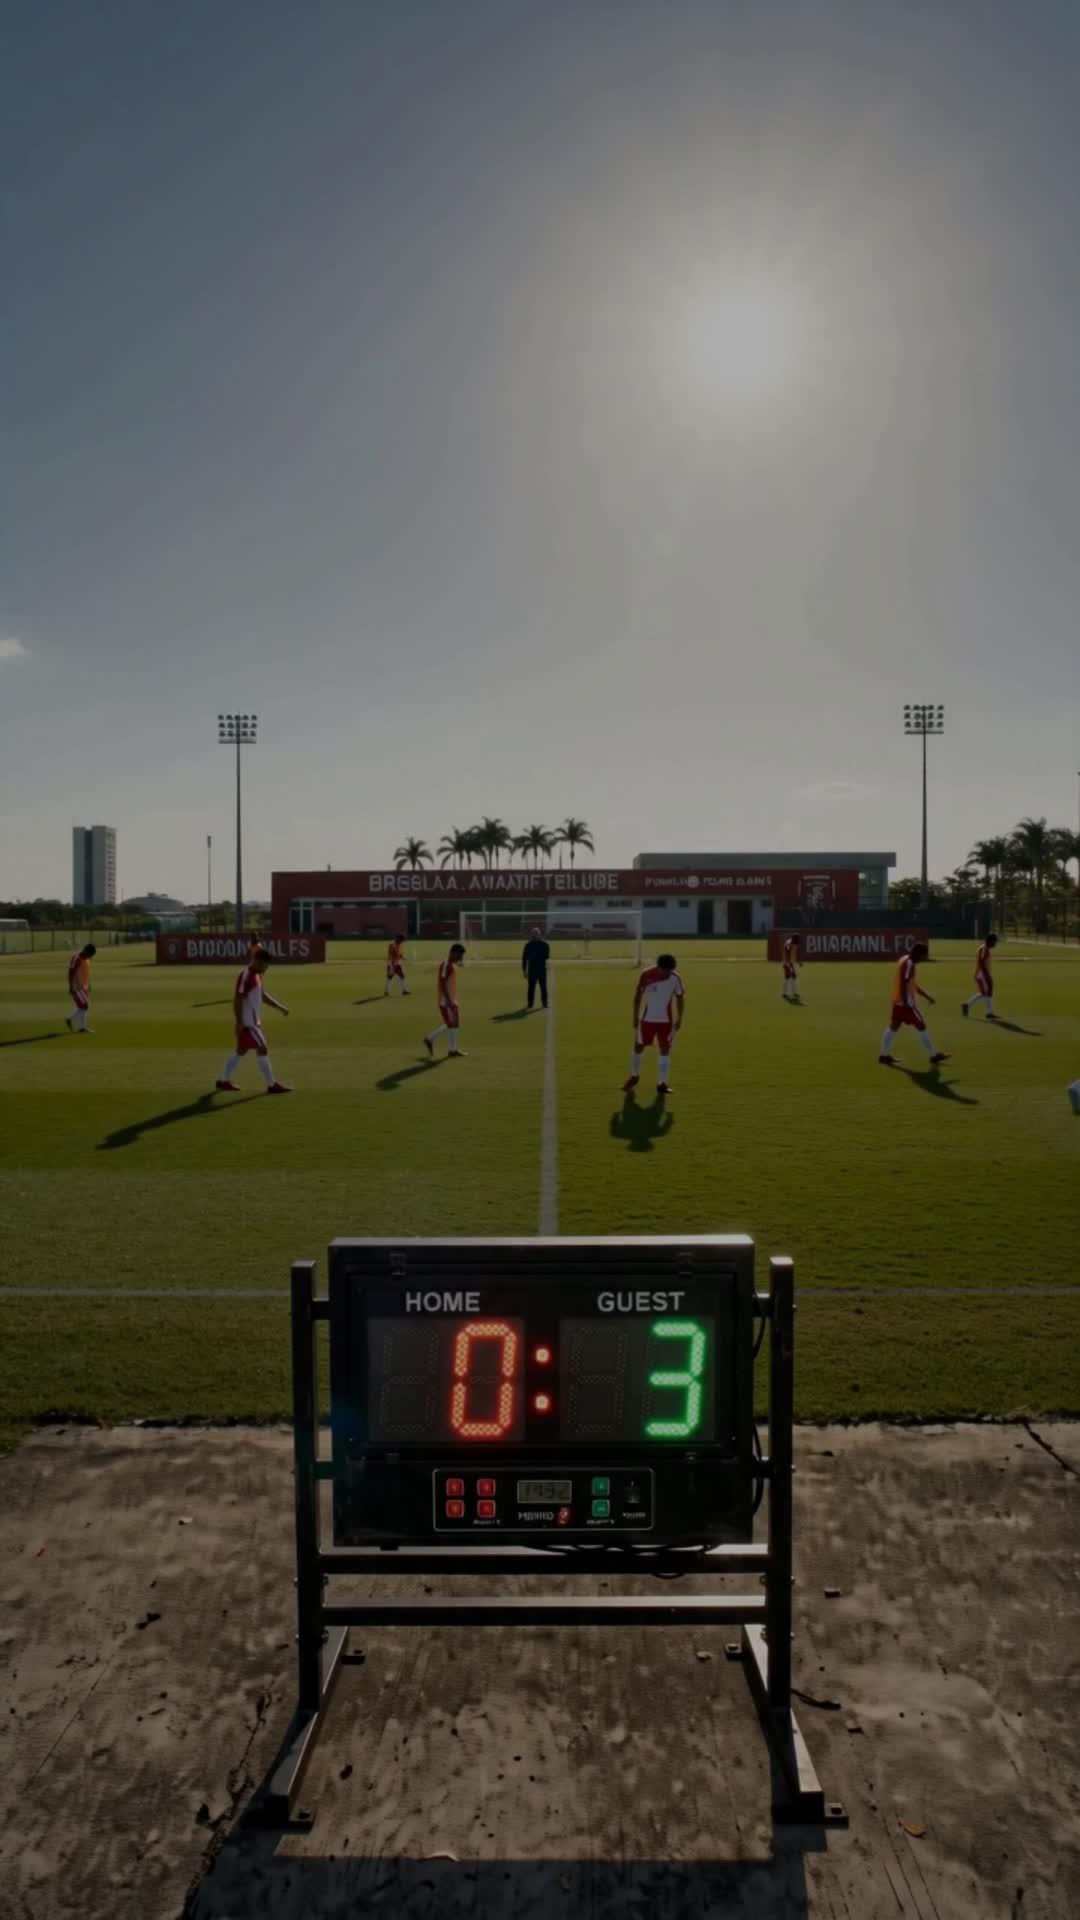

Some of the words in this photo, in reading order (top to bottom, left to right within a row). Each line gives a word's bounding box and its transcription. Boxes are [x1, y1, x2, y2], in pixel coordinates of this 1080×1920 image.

[405, 1291, 481, 1313] HOME
[596, 1290, 686, 1313] GUEST
[451, 1321, 518, 1438] 0
[644, 1320, 707, 1438] 3
